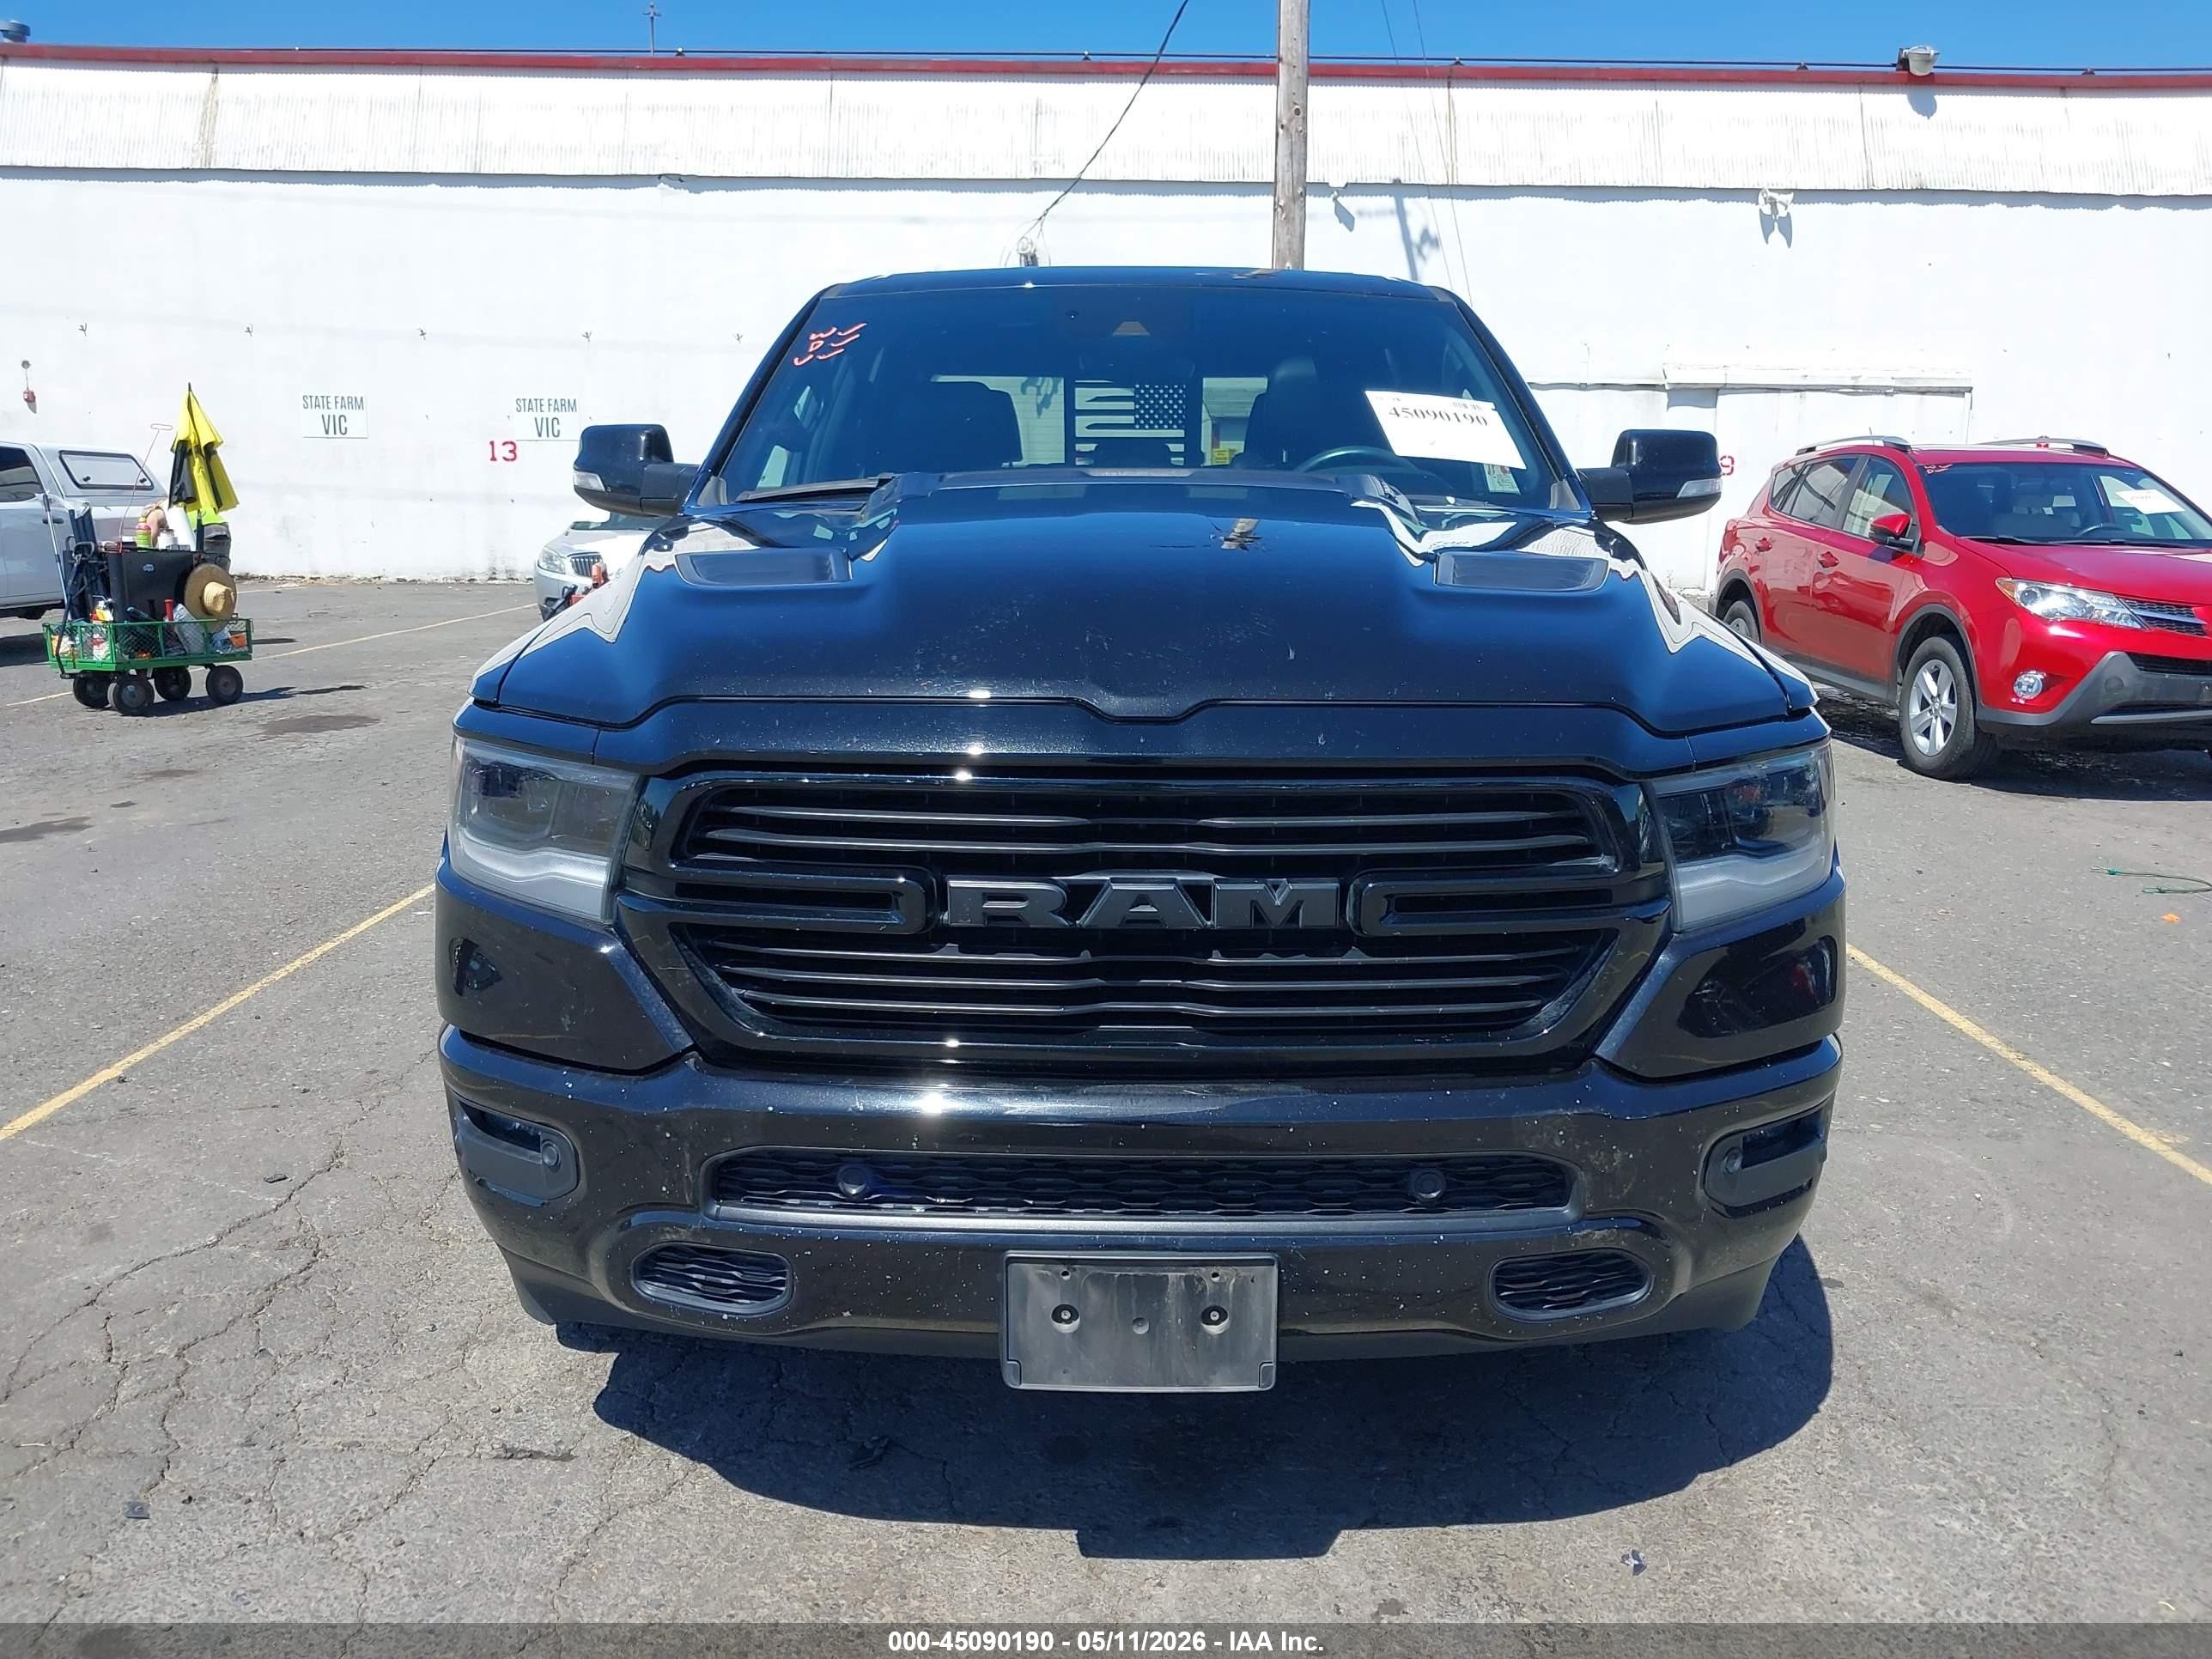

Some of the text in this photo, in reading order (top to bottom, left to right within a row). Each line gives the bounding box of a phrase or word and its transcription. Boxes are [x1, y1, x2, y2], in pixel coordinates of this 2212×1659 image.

[302, 394, 365, 411] STATE FARM
[515, 398, 578, 413] STATE FARM
[321, 414, 348, 435] VIC
[1389, 406, 1488, 426] 45090190
[534, 416, 561, 438] VIC
[489, 440, 518, 462] 13
[946, 876, 1340, 928] RAM
